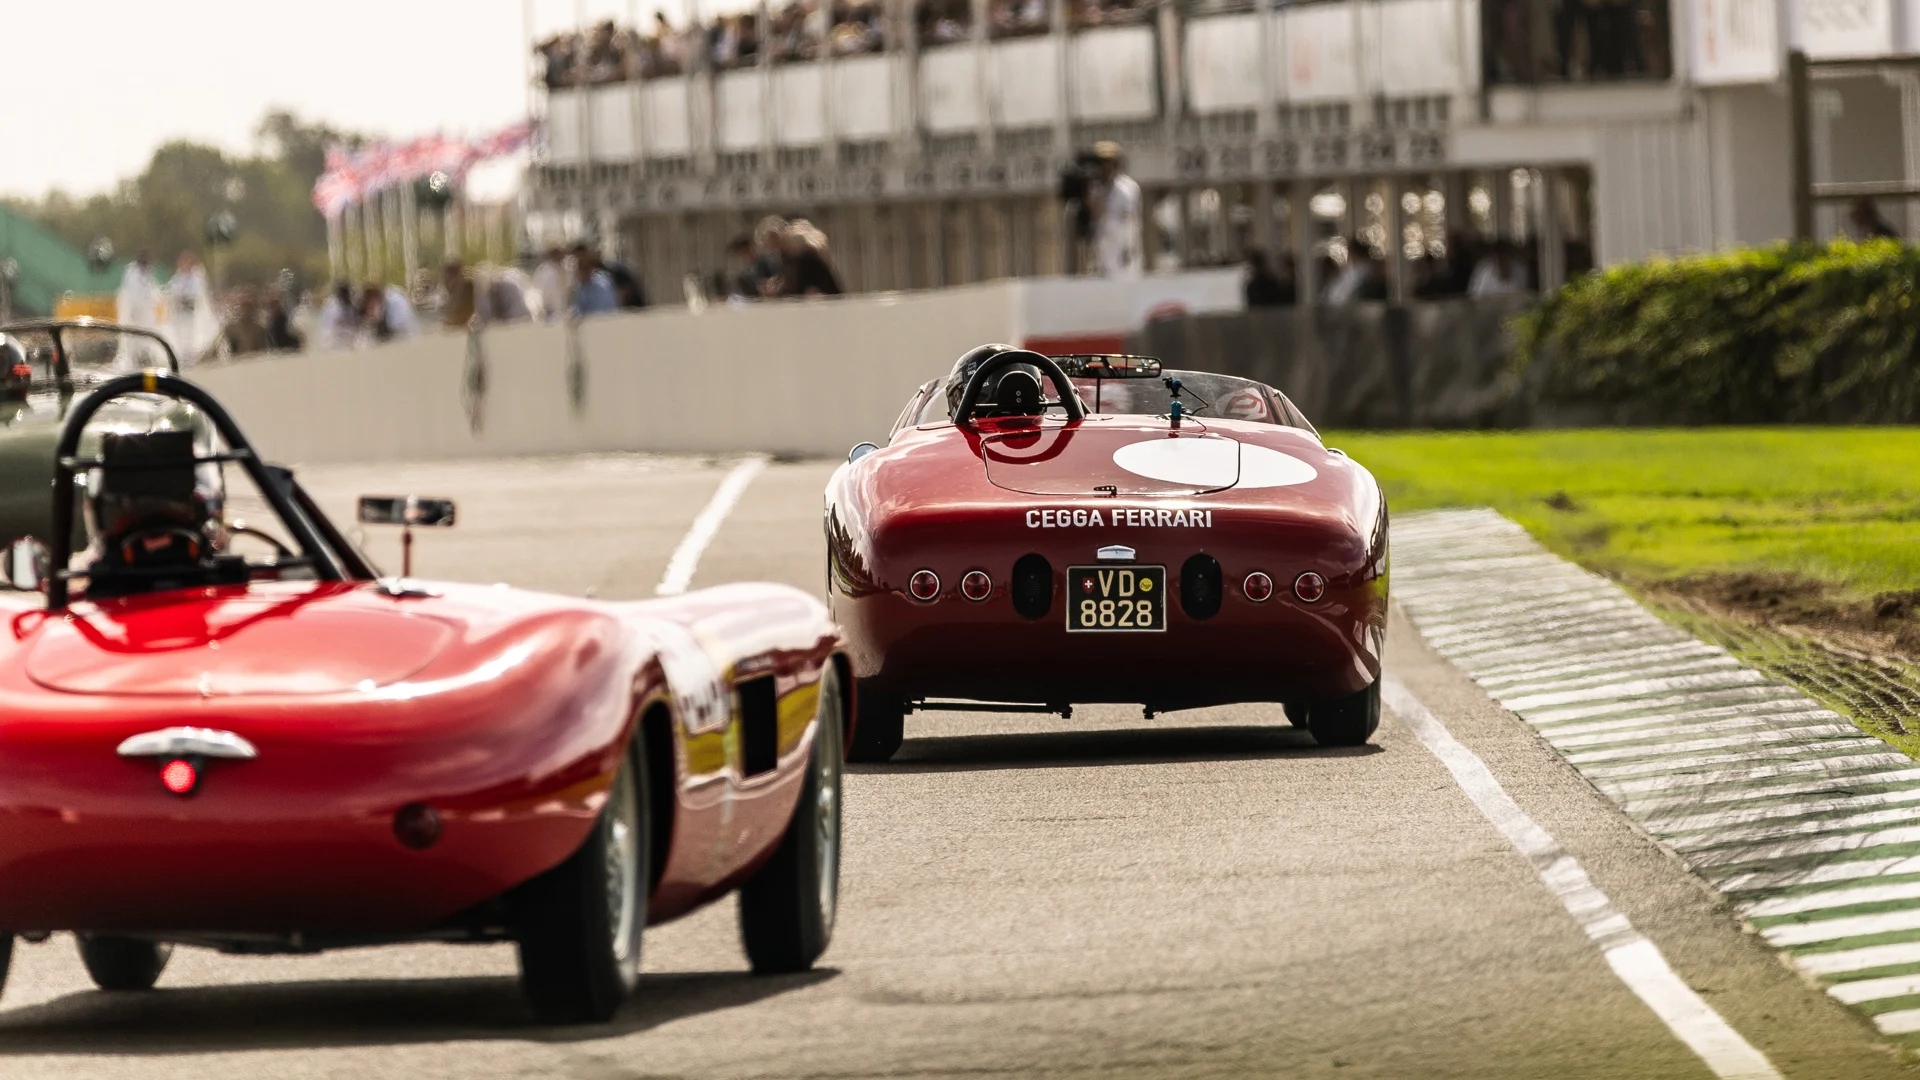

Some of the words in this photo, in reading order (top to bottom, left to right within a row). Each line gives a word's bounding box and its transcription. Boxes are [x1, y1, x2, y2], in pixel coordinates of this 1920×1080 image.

[1026, 509, 1104, 528] CEGGA
[1112, 509, 1212, 528] FERRARI
[1098, 570, 1135, 597] VD
[1080, 600, 1153, 627] 8828
